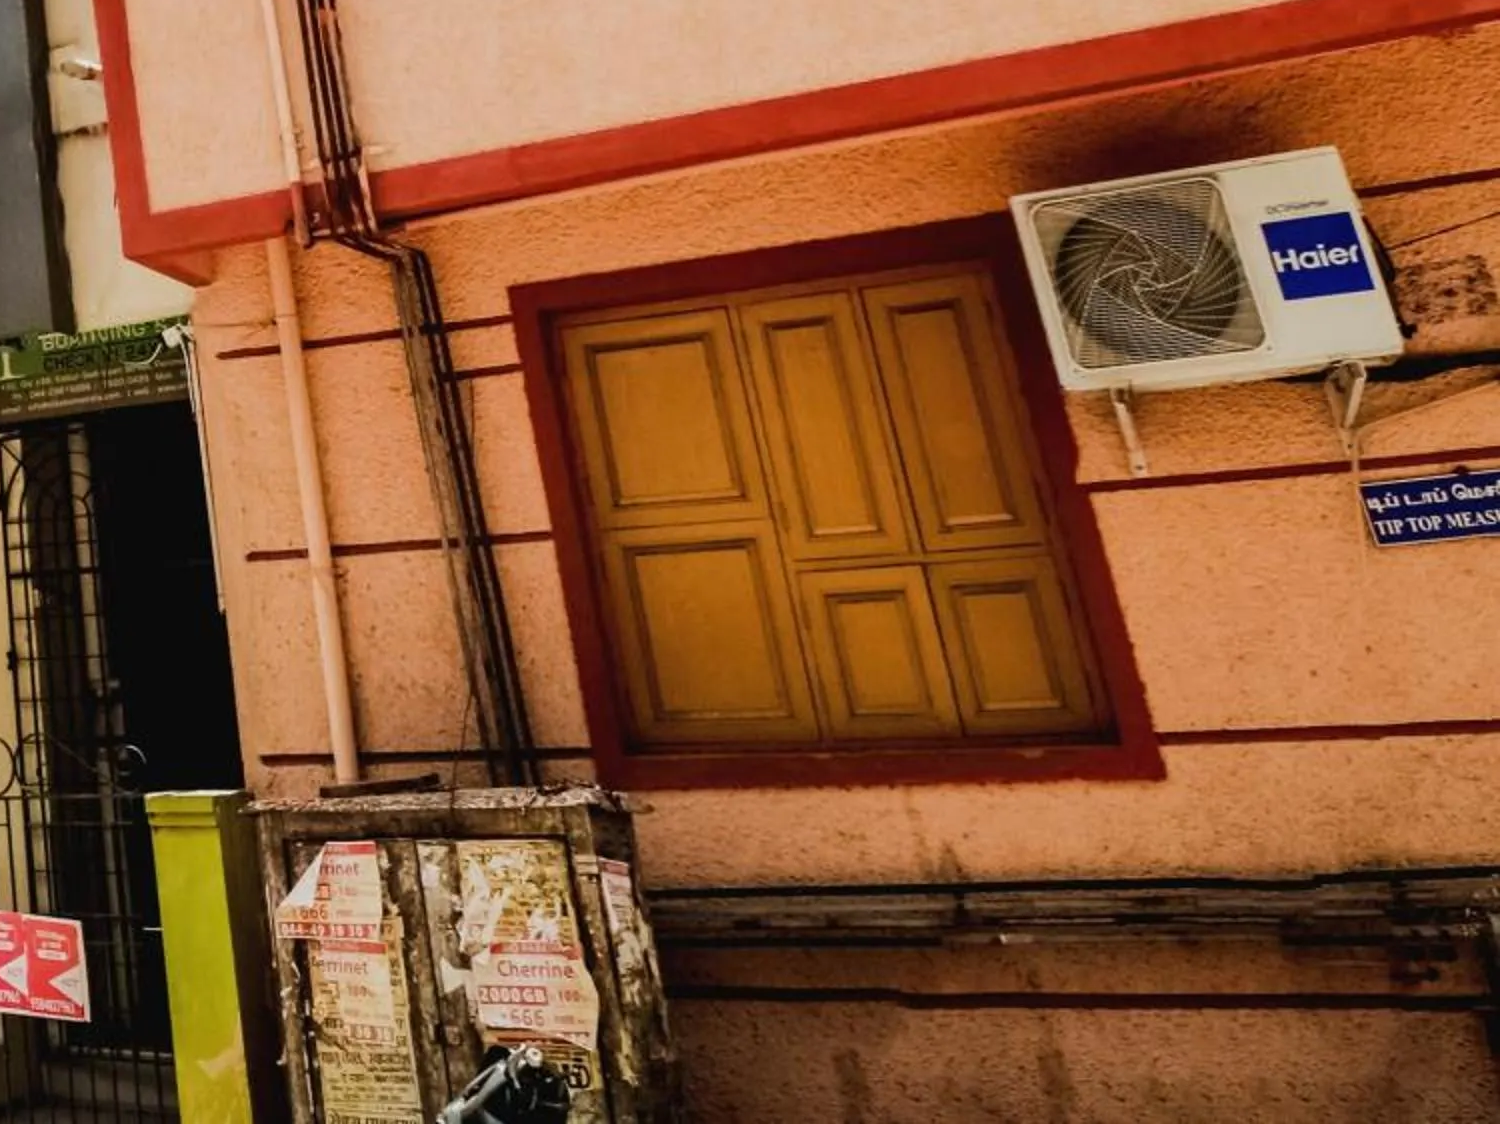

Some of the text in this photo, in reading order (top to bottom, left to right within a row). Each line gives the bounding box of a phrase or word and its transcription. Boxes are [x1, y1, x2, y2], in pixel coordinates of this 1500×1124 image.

[1272, 243, 1360, 273] Haier
[1374, 519, 1405, 536] TIP
[1405, 515, 1443, 533] TOP
